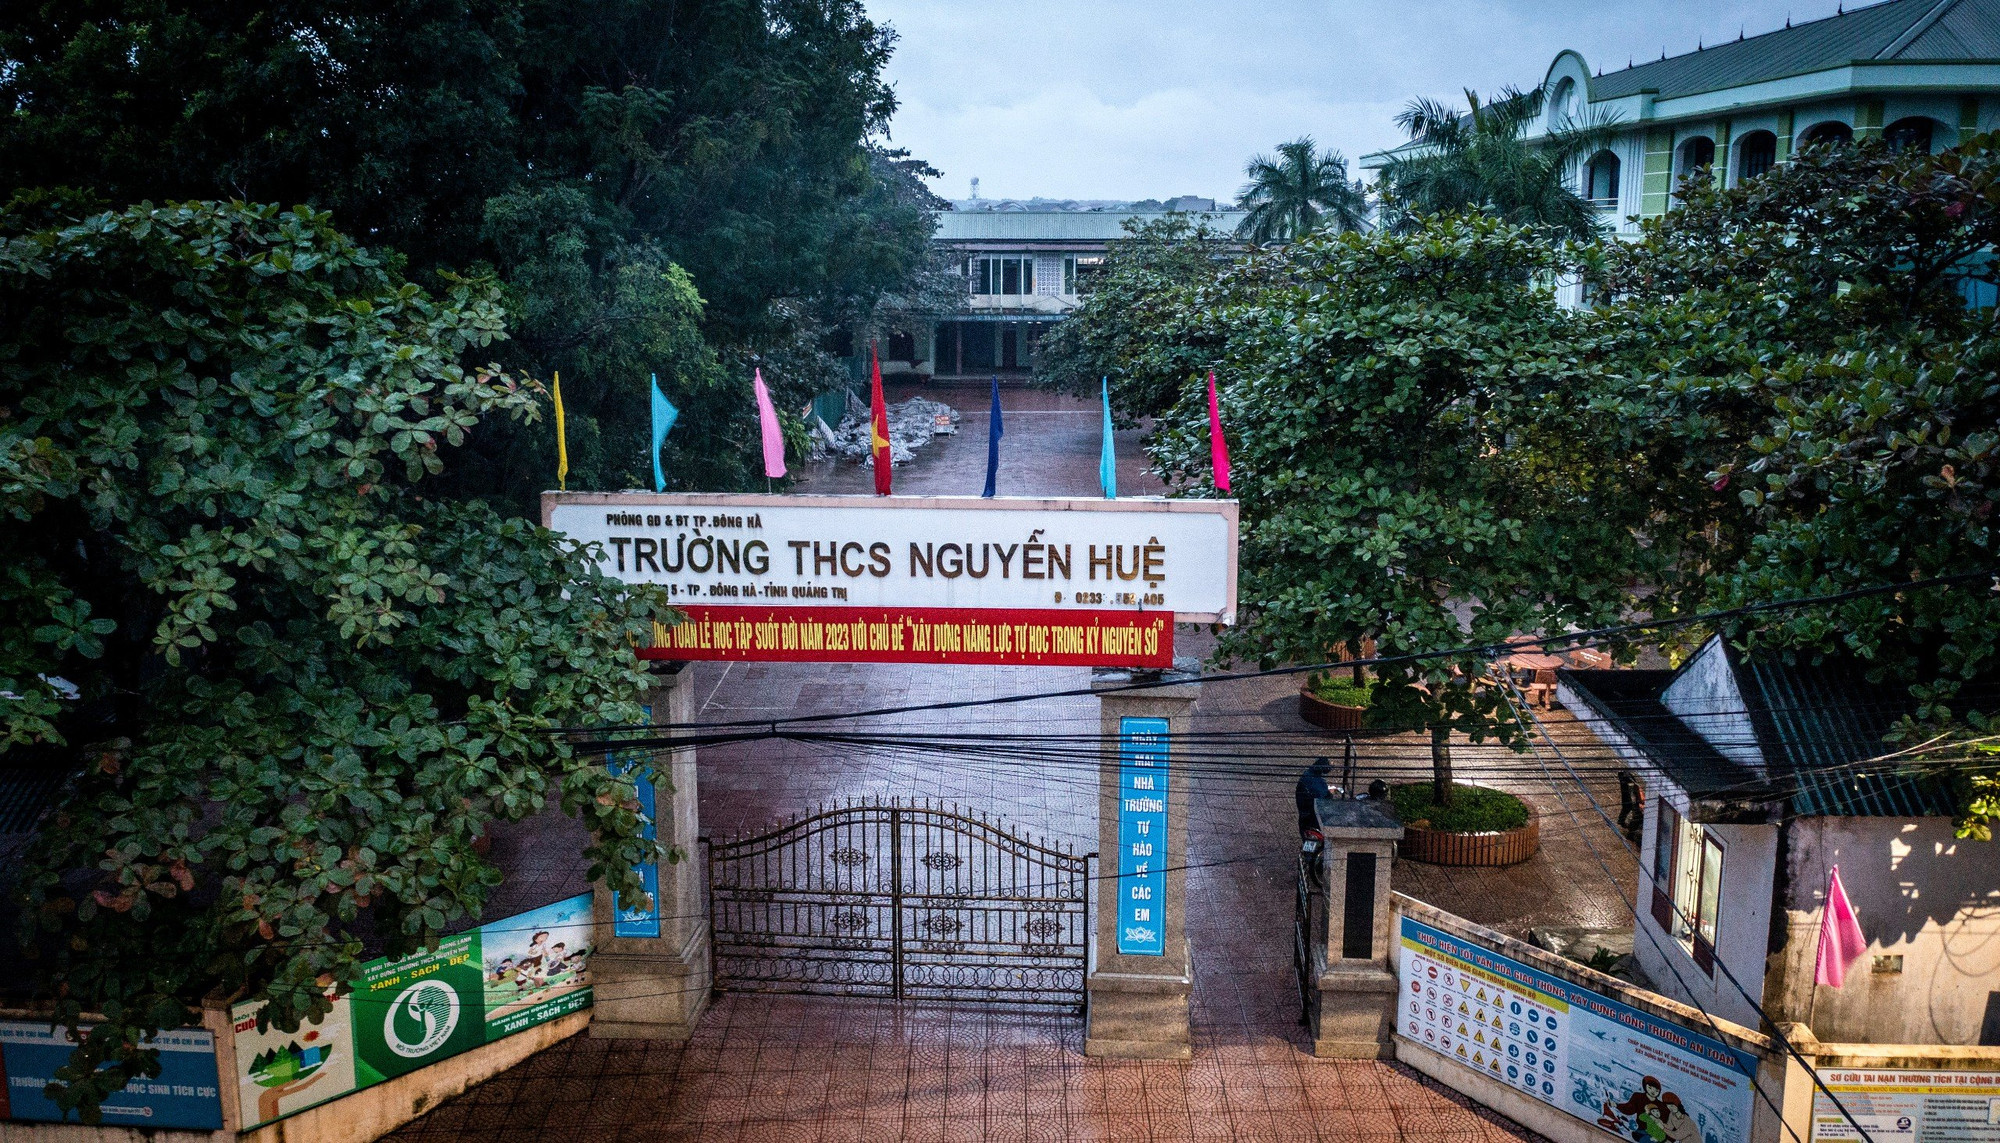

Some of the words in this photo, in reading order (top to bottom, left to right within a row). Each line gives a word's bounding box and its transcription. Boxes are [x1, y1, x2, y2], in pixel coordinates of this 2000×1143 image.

[606, 511, 642, 526] PHÒNG
[646, 514, 661, 527] GD
[664, 514, 672, 527] &
[746, 513, 762, 528] HÀ
[609, 528, 770, 575] TRƯỜNG
[787, 540, 892, 578] THCS
[909, 528, 1072, 580] NGUYỄN
[1089, 536, 1166, 588] HUỆ
[671, 583, 678, 596] 5
[709, 582, 738, 598] ĐÔNG
[792, 582, 828, 598] QUẢNG
[832, 587, 848, 601] TRỊ
[699, 612, 711, 648] LỄ
[713, 622, 732, 655] HỌC
[735, 618, 752, 656] TẬP
[755, 613, 779, 650] SUỐT
[782, 617, 798, 650] ĐỜI
[801, 617, 823, 650] NĂM
[826, 623, 849, 650] 2023
[851, 617, 868, 651] VỚI
[870, 613, 889, 651] CHỦ
[891, 613, 904, 651] ĐỀ
[934, 621, 960, 658] DỰNG
[963, 617, 990, 652] NĂNG
[993, 622, 1012, 659] LỰC
[1015, 622, 1028, 659] TỰ
[1029, 625, 1049, 660] HỌC
[1051, 626, 1084, 655] TRONG
[1087, 617, 1100, 656] KỶ
[1102, 622, 1142, 656] NGUYÊN
[1133, 772, 1154, 791] NHÀ
[1124, 797, 1163, 813] TRƯỜNG
[1136, 820, 1150, 838] TỰ
[1132, 840, 1152, 856] HÀO
[1131, 883, 1152, 900] CÁC
[1134, 908, 1150, 922] EM
[370, 976, 400, 992] XANH
[410, 963, 440, 978] SẠCH
[449, 953, 470, 966] ĐẸP
[1472, 966, 1485, 978] GIAO
[1417, 932, 1437, 946] THỰC
[1439, 940, 1457, 956] HIỆN
[1459, 947, 1474, 962] TỐT
[1476, 953, 1492, 968] VĂN
[1494, 961, 1512, 977] HÓA
[1513, 970, 1534, 985] GIAO
[1570, 993, 1588, 1007] XÂY
[1590, 1001, 1616, 1018] DỰNG
[1619, 1012, 1645, 1030] CỔNG
[1647, 1023, 1687, 1046] TRƯỜNG
[1690, 1040, 1704, 1054] AN
[1707, 1047, 1735, 1067] TOÀN
[504, 1017, 528, 1032] XANH
[537, 1005, 560, 1020] SẠCH
[568, 997, 585, 1010] ĐẸP
[1844, 1073, 1860, 1082] CỨU
[1864, 1074, 1875, 1082] TAI
[1877, 1074, 1895, 1084] NẠN
[1898, 1074, 1931, 1084] THƯƠNG
[1934, 1073, 1952, 1084] TÍCH
[1954, 1075, 1967, 1086] TẠI
[1970, 1075, 1993, 1086] CỘNG
[148, 1084, 170, 1095] SINH
[172, 1083, 194, 1096] TÍCH
[197, 1085, 216, 1098] CỰC
